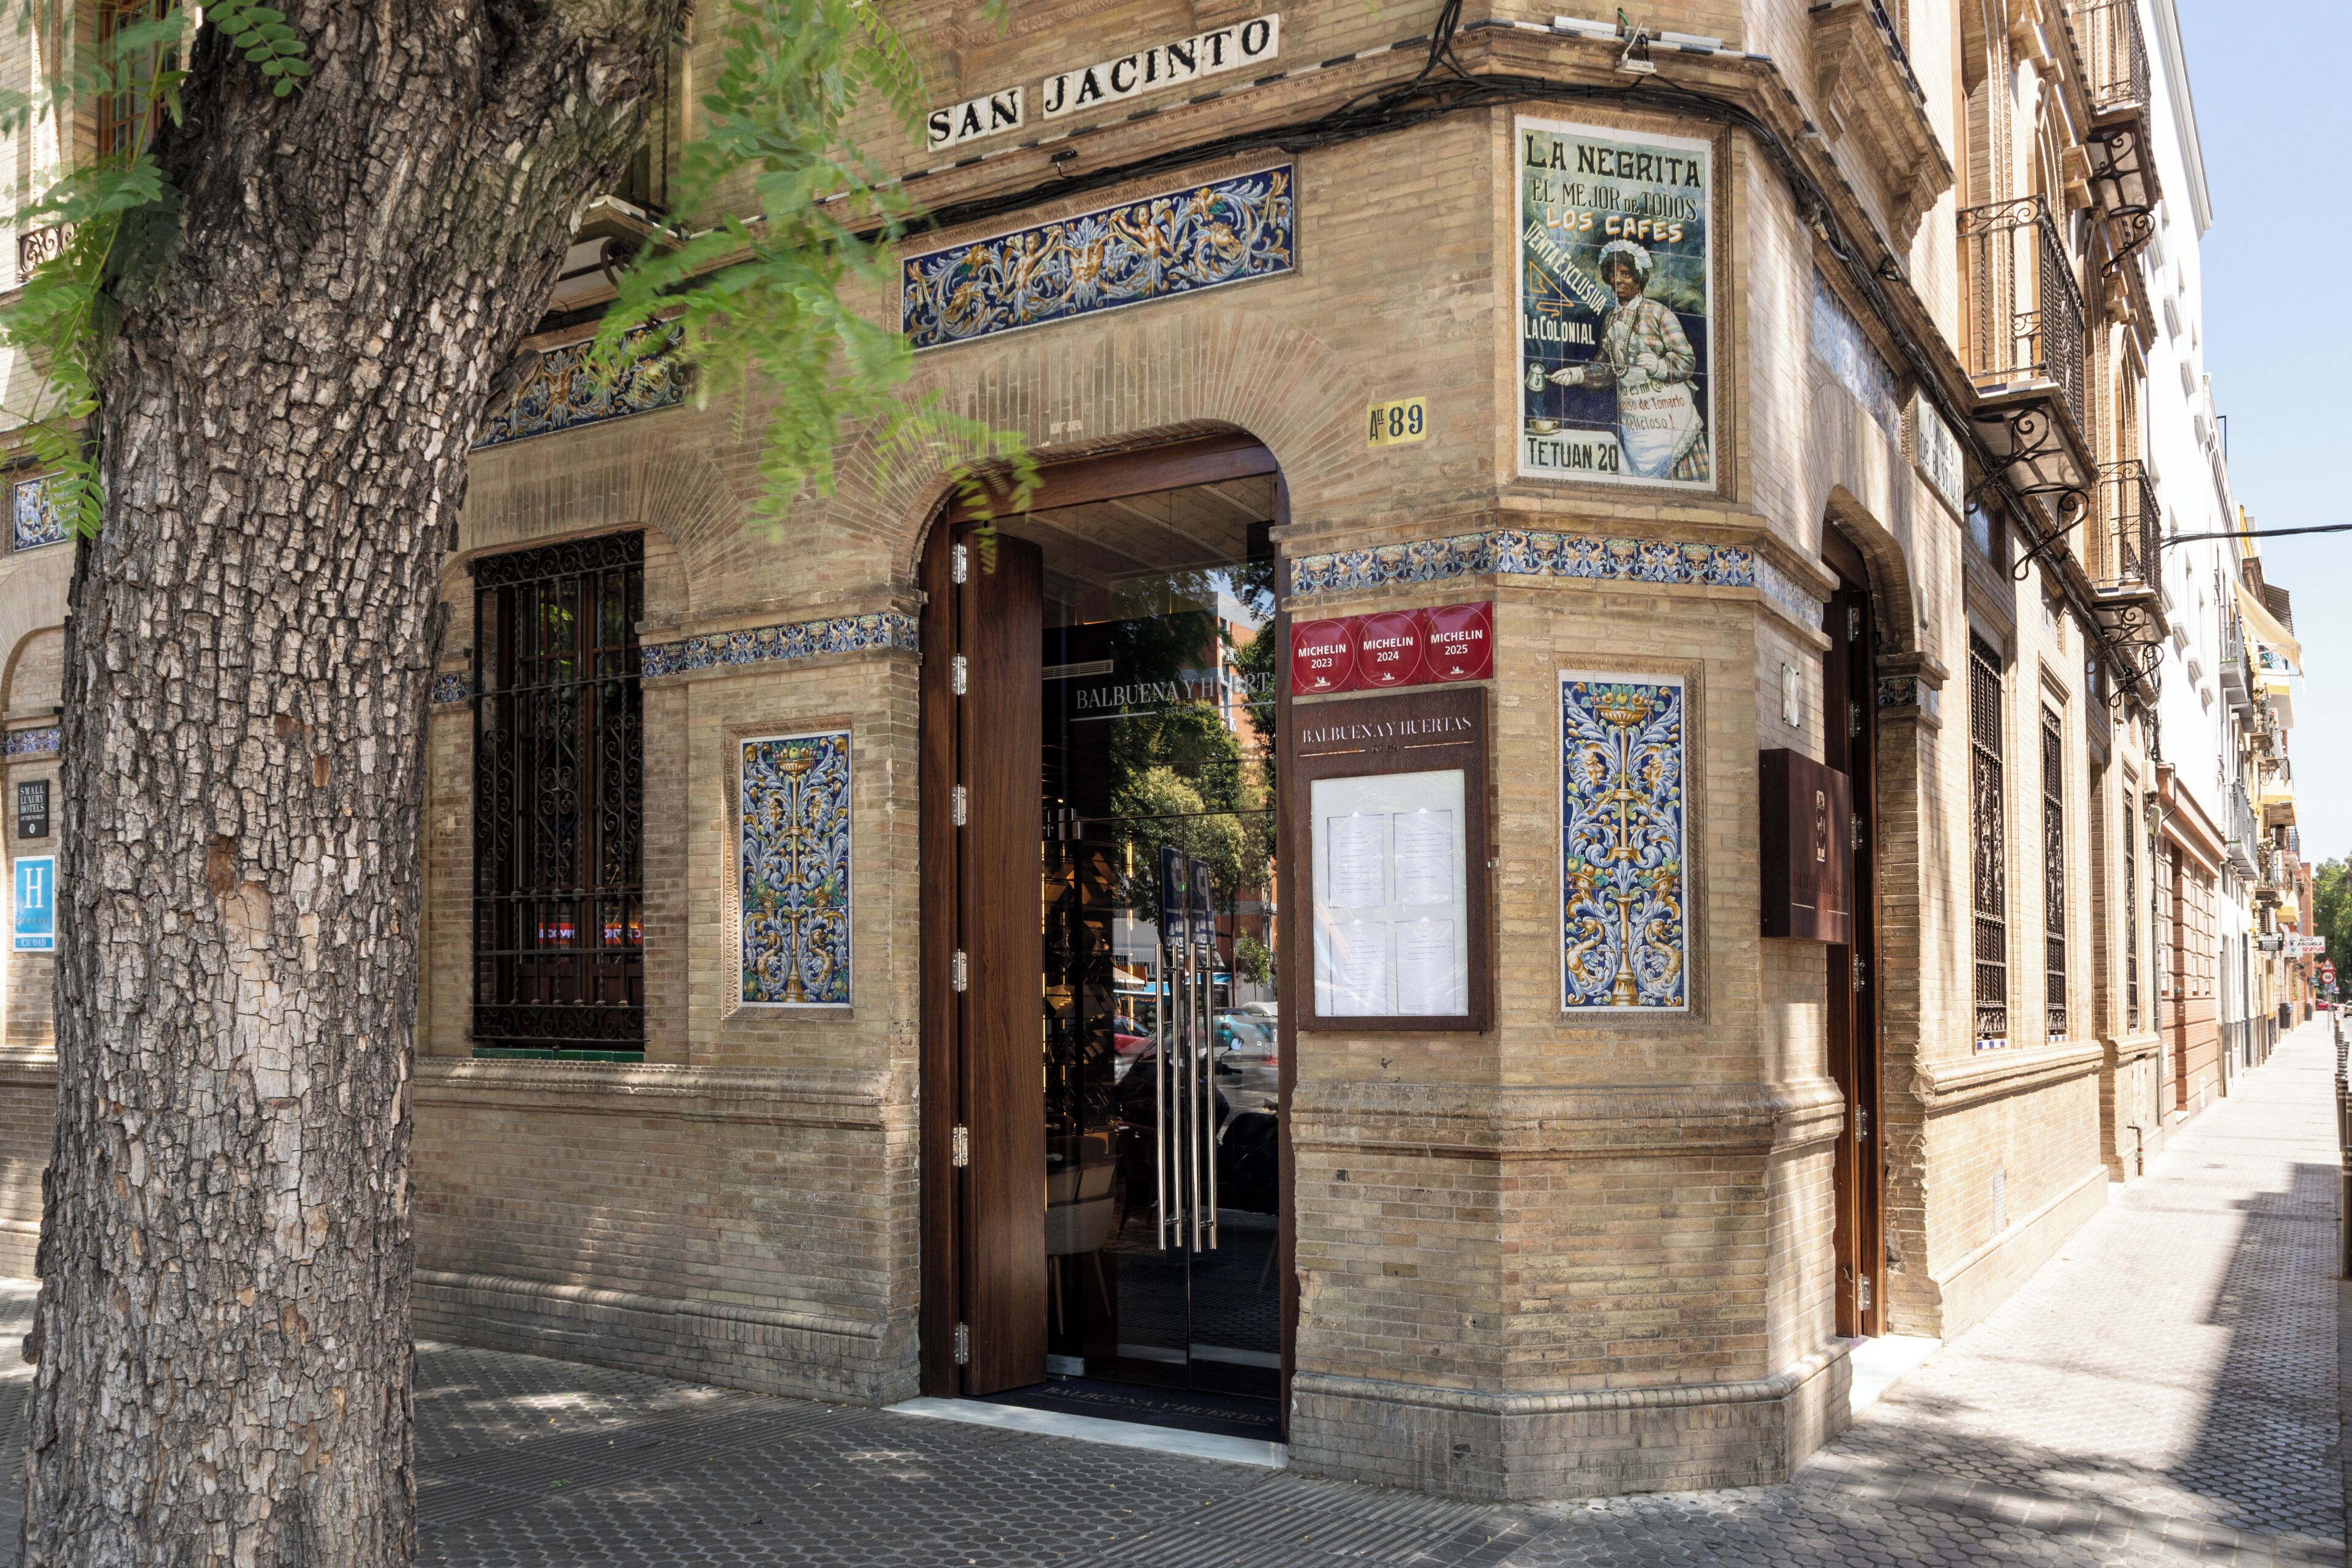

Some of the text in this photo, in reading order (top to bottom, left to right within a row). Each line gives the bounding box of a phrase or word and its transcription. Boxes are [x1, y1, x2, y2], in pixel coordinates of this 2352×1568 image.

[929, 19, 1271, 142] SAN JACINTO
[1526, 134, 1701, 189] LA NEGRITA
[1532, 179, 1697, 222] EL MEJOR DE TODOS
[1547, 207, 1594, 232] LOS
[1523, 220, 1607, 315] VENTA EXCLUSIVA
[1525, 314, 1596, 345] LA COLONIAL
[1630, 386, 1638, 396] es
[1640, 380, 1650, 394] mi
[1639, 398, 1650, 410] de
[1651, 394, 1685, 409] tomarlo
[1389, 404, 1423, 437] 89
[1928, 413, 1953, 467] CONDES
[1528, 437, 1618, 472] TETUAN 20
[1920, 432, 1962, 508] DE BUSTILLO
[1363, 637, 1413, 650] MICHELIN
[1430, 630, 1483, 644] MICHELIN
[1298, 644, 1346, 658] MICHELIN
[1377, 651, 1399, 662] 2024
[1445, 644, 1468, 655] 2025
[1311, 658, 1332, 669] 2023
[1076, 672, 1275, 709] BALBUENA Y HUERT
[1182, 705, 1199, 714] 1924
[1303, 716, 1471, 744] BALBUENA Y HUERTAS
[20, 785, 44, 796] SMALL
[20, 794, 44, 804] LUXURY
[20, 804, 44, 813] HOTELS
[24, 867, 44, 908] H
[21, 938, 46, 947] CIUDAD
